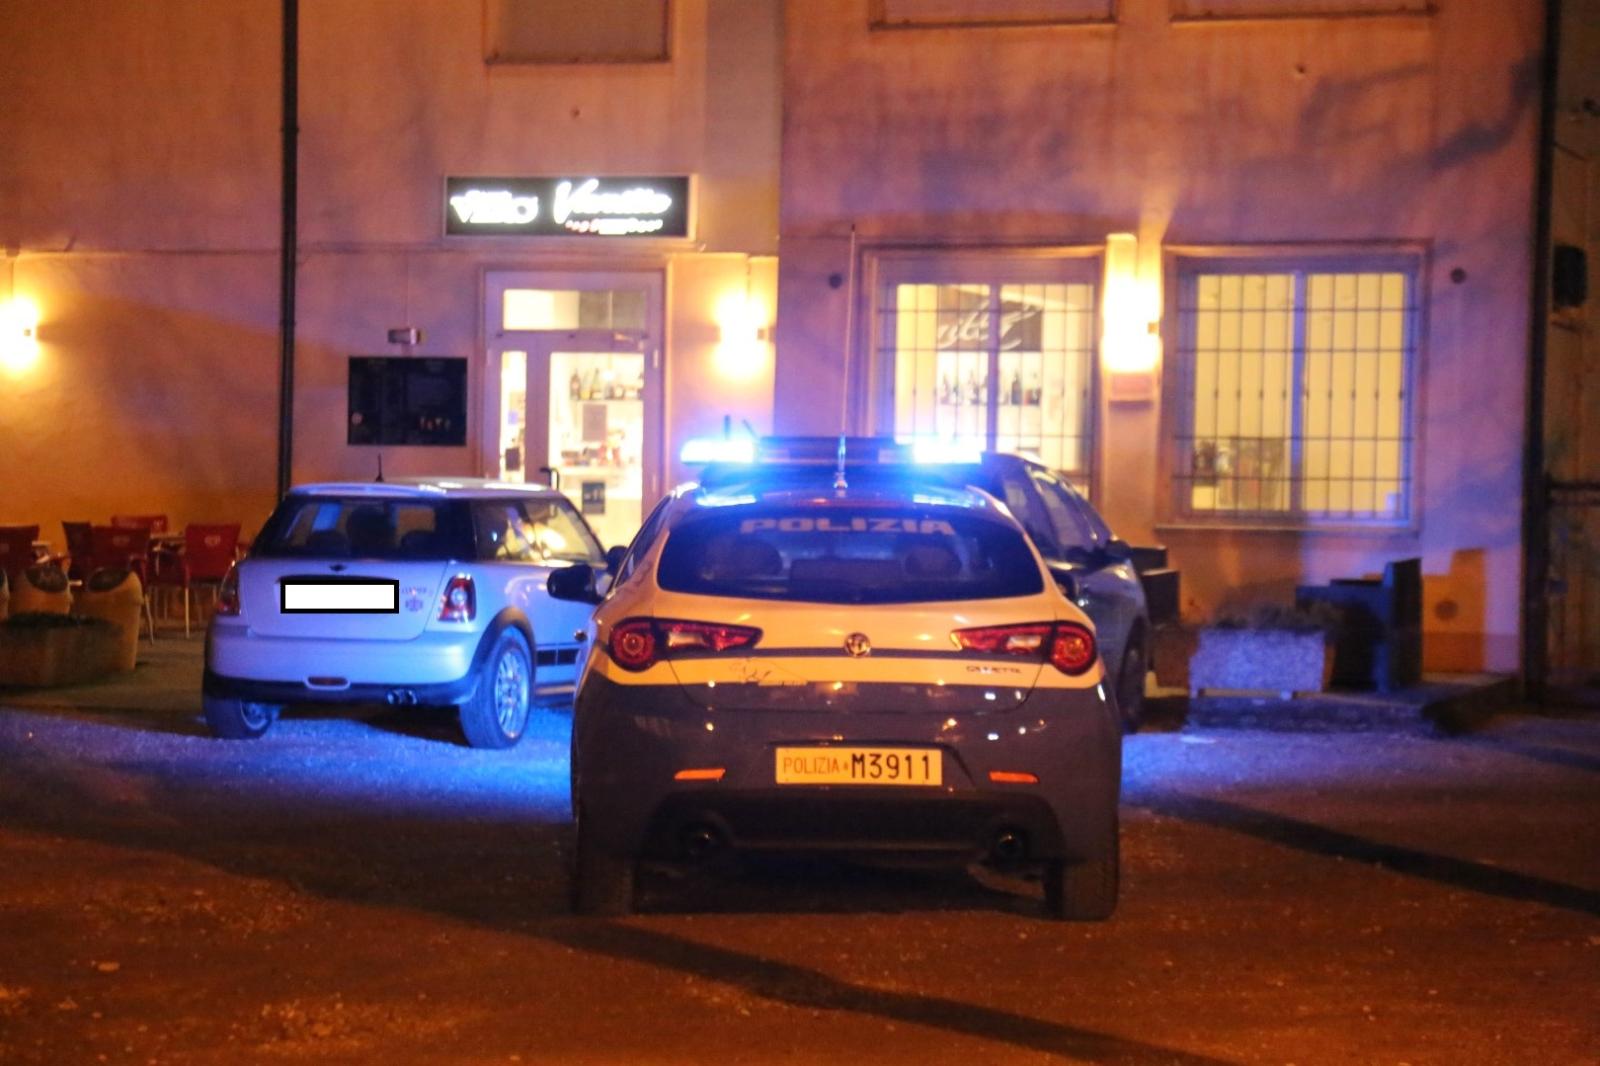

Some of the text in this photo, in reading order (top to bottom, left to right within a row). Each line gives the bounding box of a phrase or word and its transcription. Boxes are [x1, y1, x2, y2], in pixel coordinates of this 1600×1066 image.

[740, 518, 956, 535] POLIZIA
[783, 752, 930, 780] POLIZIA M3911
